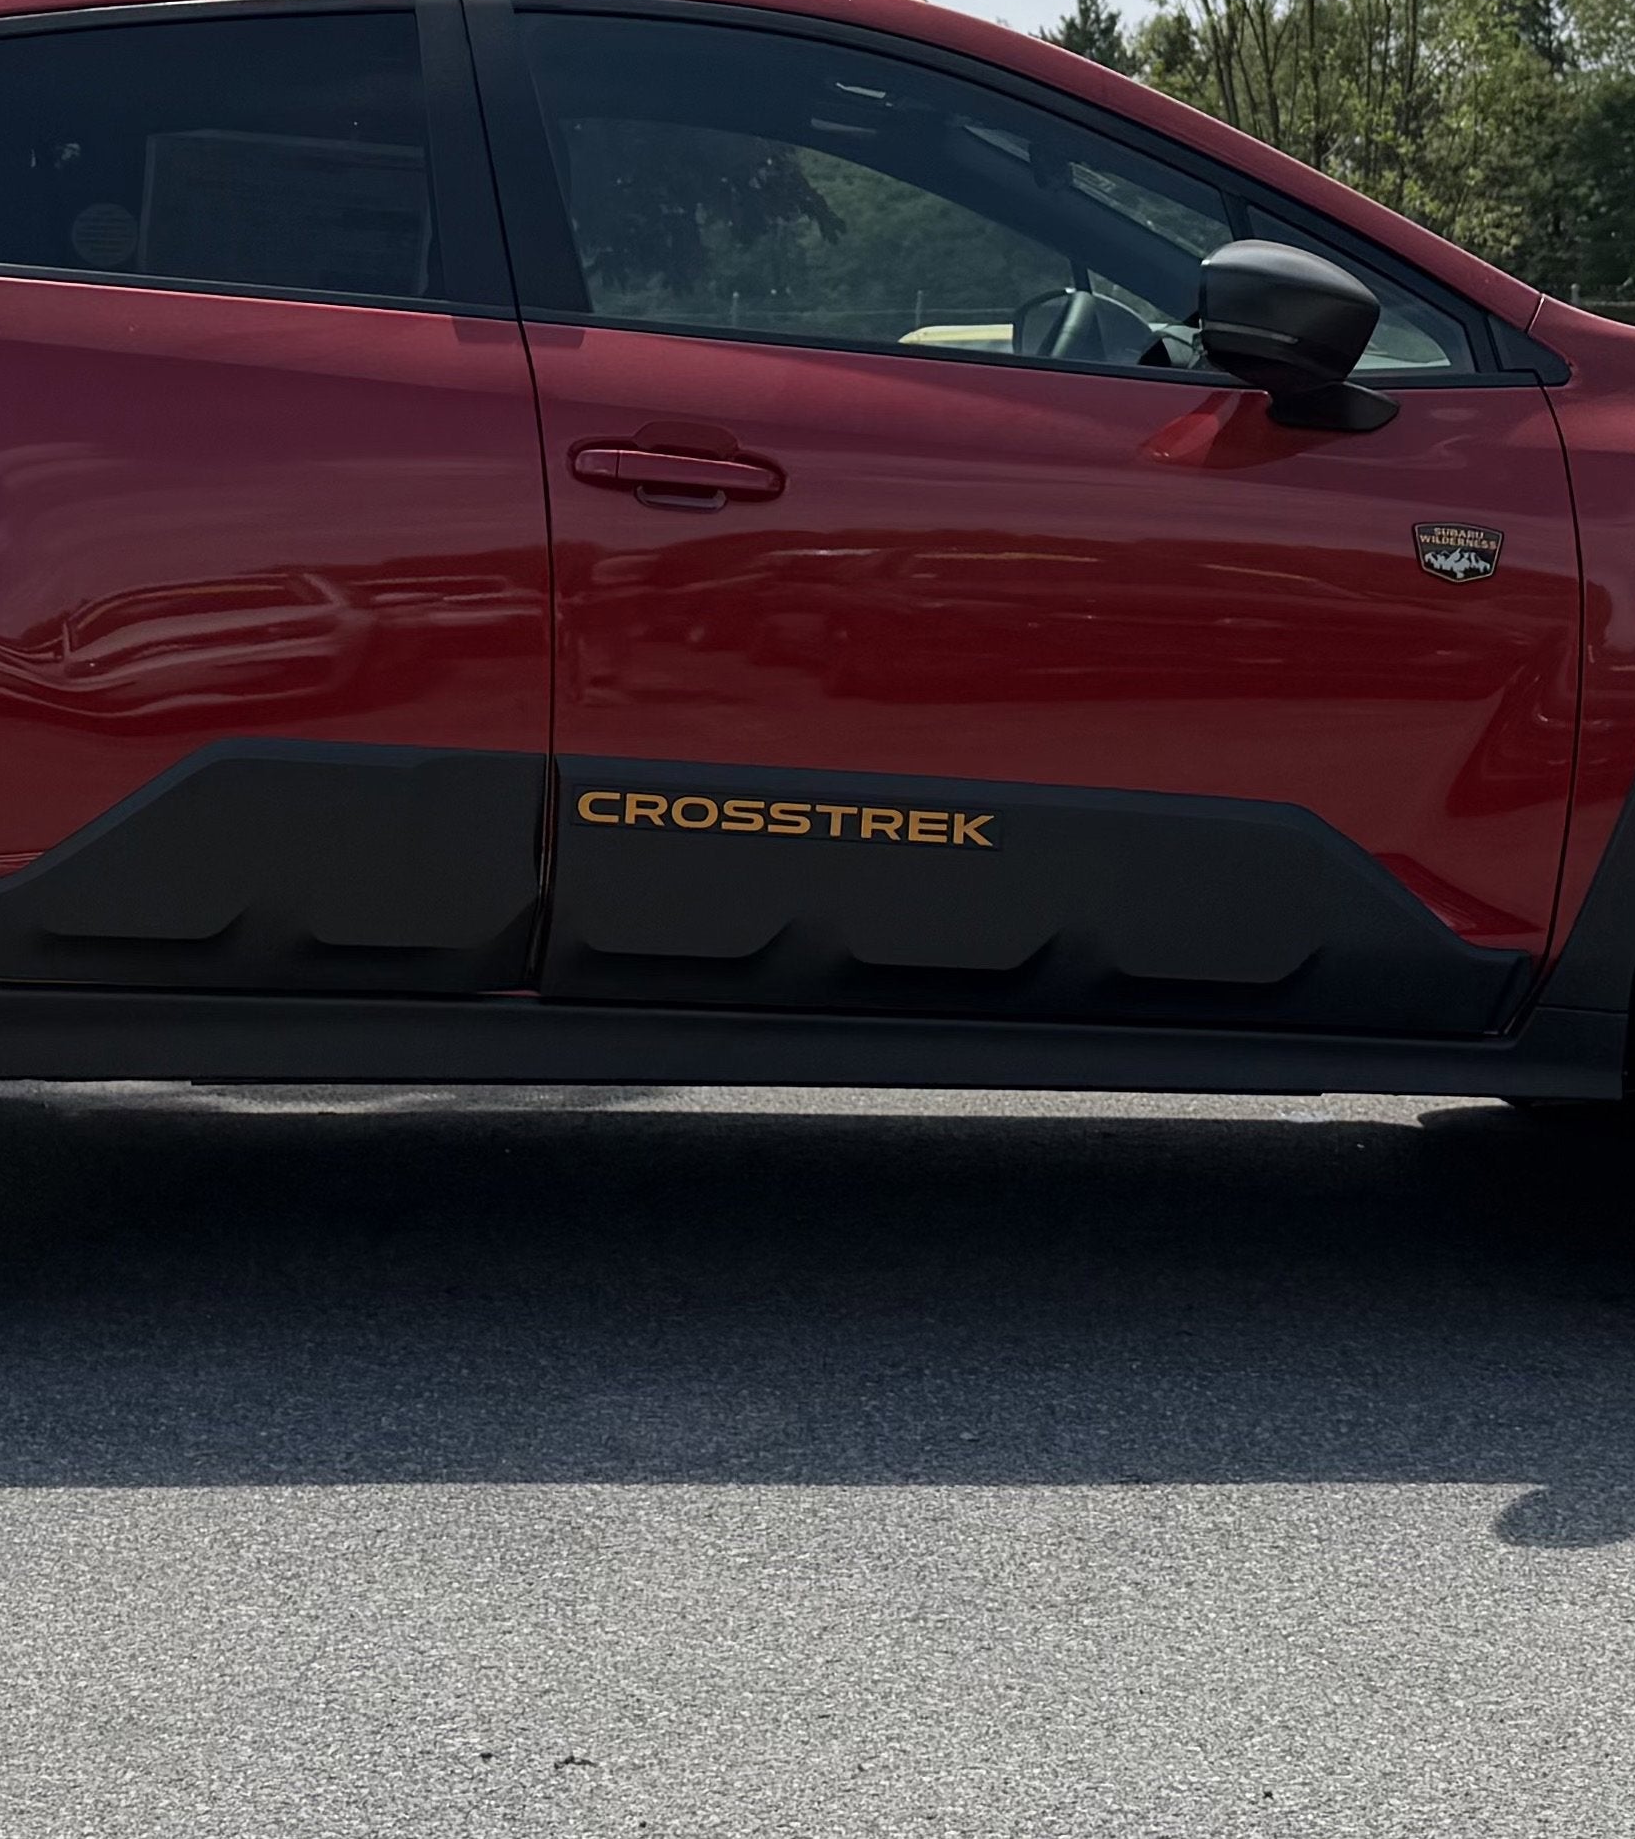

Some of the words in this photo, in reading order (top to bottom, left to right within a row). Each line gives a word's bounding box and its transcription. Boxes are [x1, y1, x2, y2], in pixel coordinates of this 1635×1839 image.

[1419, 533, 1498, 550] WILDERNESS
[1433, 526, 1485, 540] SUBARU
[577, 790, 995, 847] CROSSTREK
